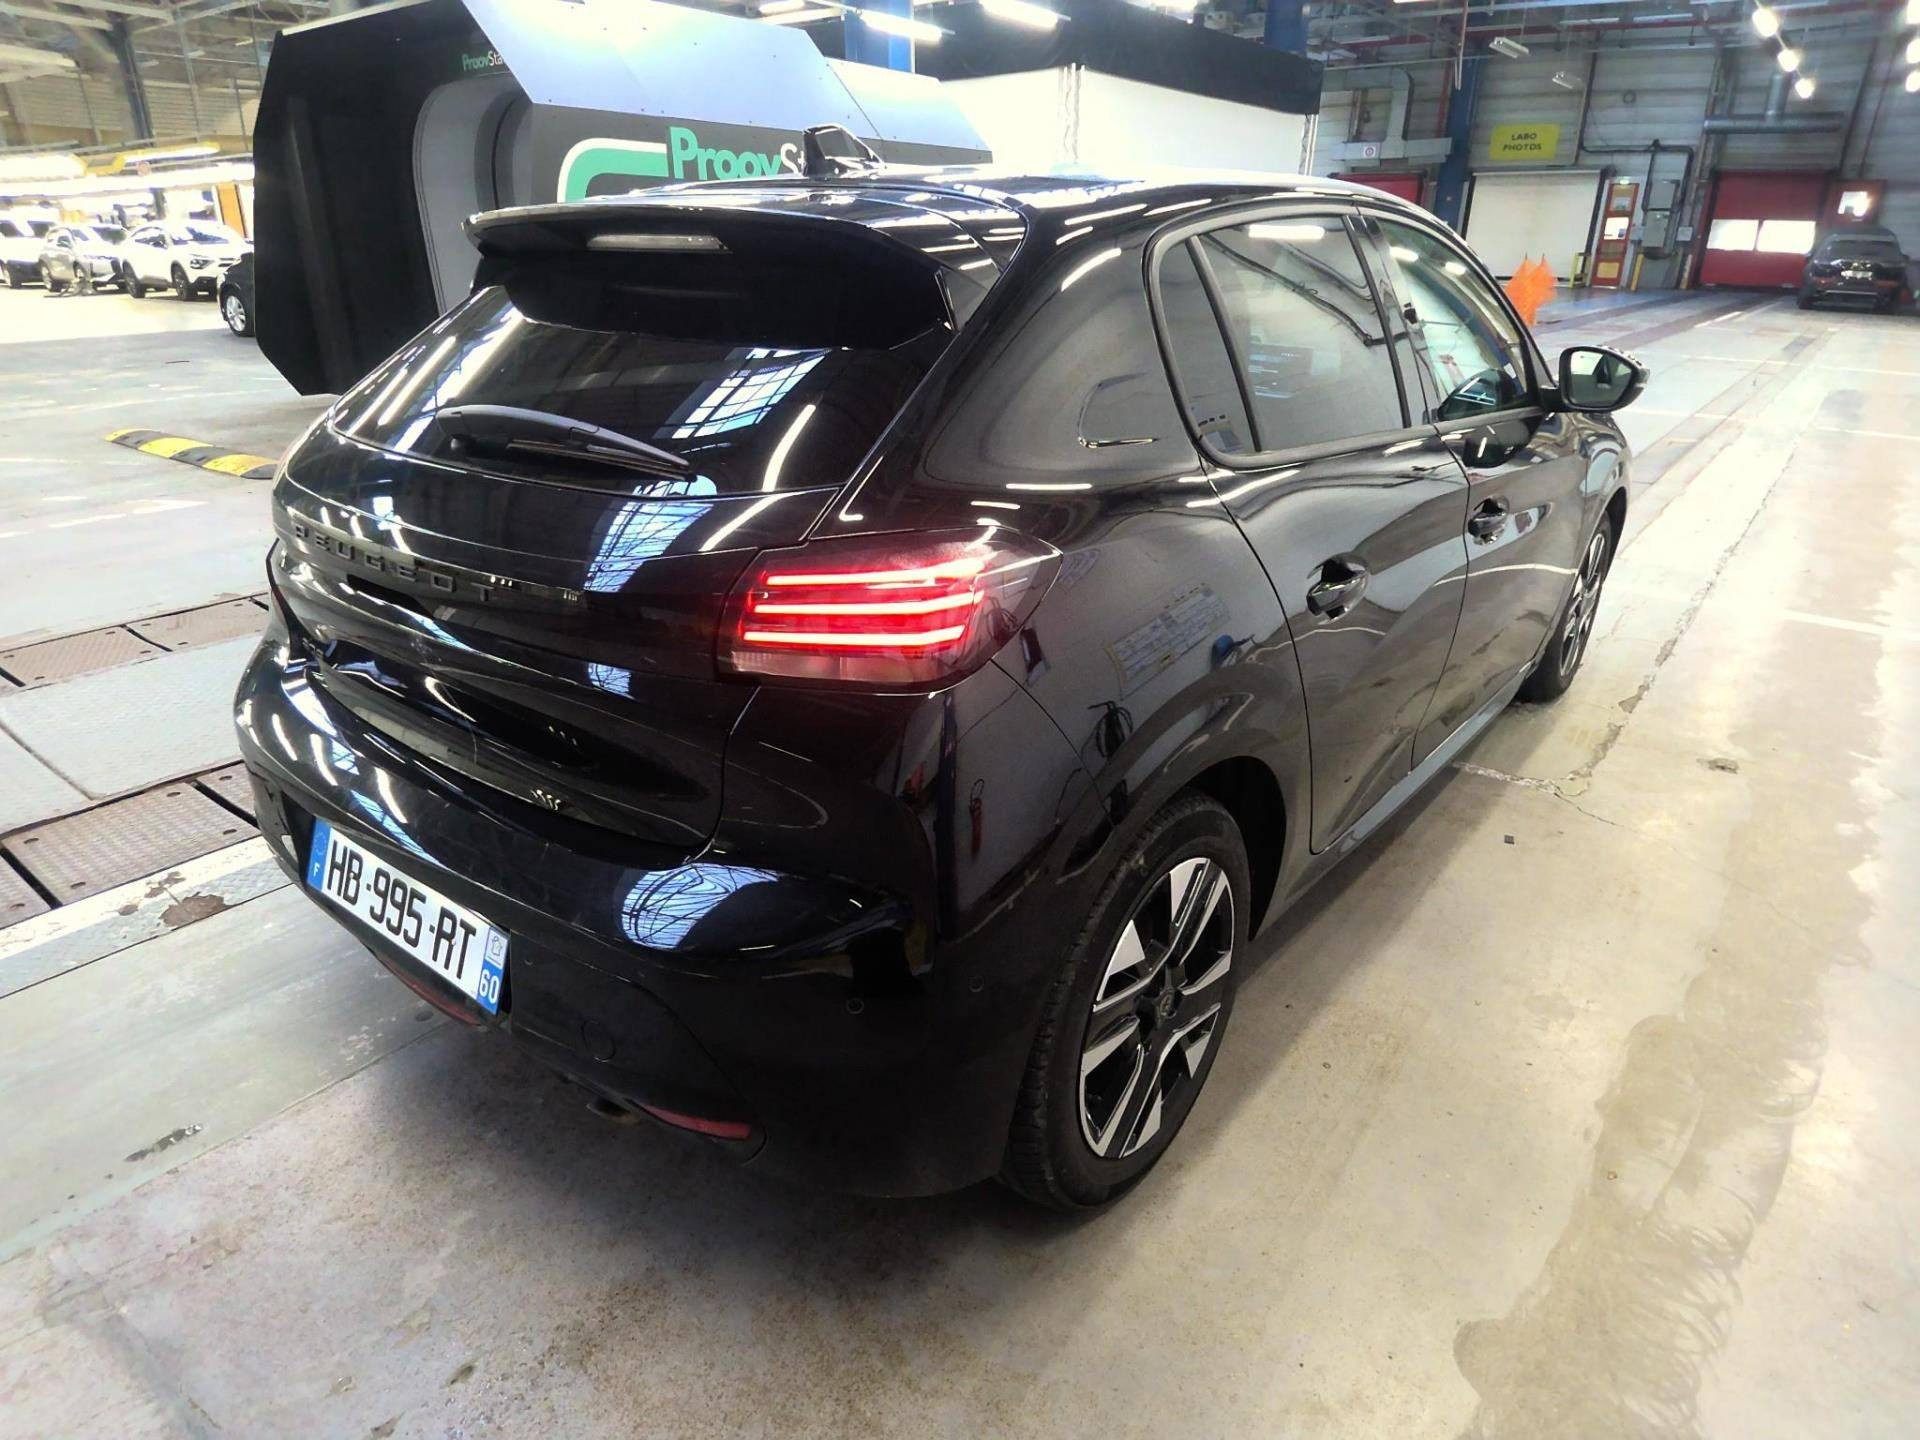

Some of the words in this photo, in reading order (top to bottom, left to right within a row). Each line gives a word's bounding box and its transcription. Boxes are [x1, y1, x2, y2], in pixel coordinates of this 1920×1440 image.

[1502, 143, 1542, 152] PHOTOS
[1511, 132, 1537, 141] LABO
[292, 521, 495, 602] PEUGEOT
[313, 862, 320, 877] F
[326, 839, 477, 980] HB-995-RT
[479, 968, 500, 1004] 60
